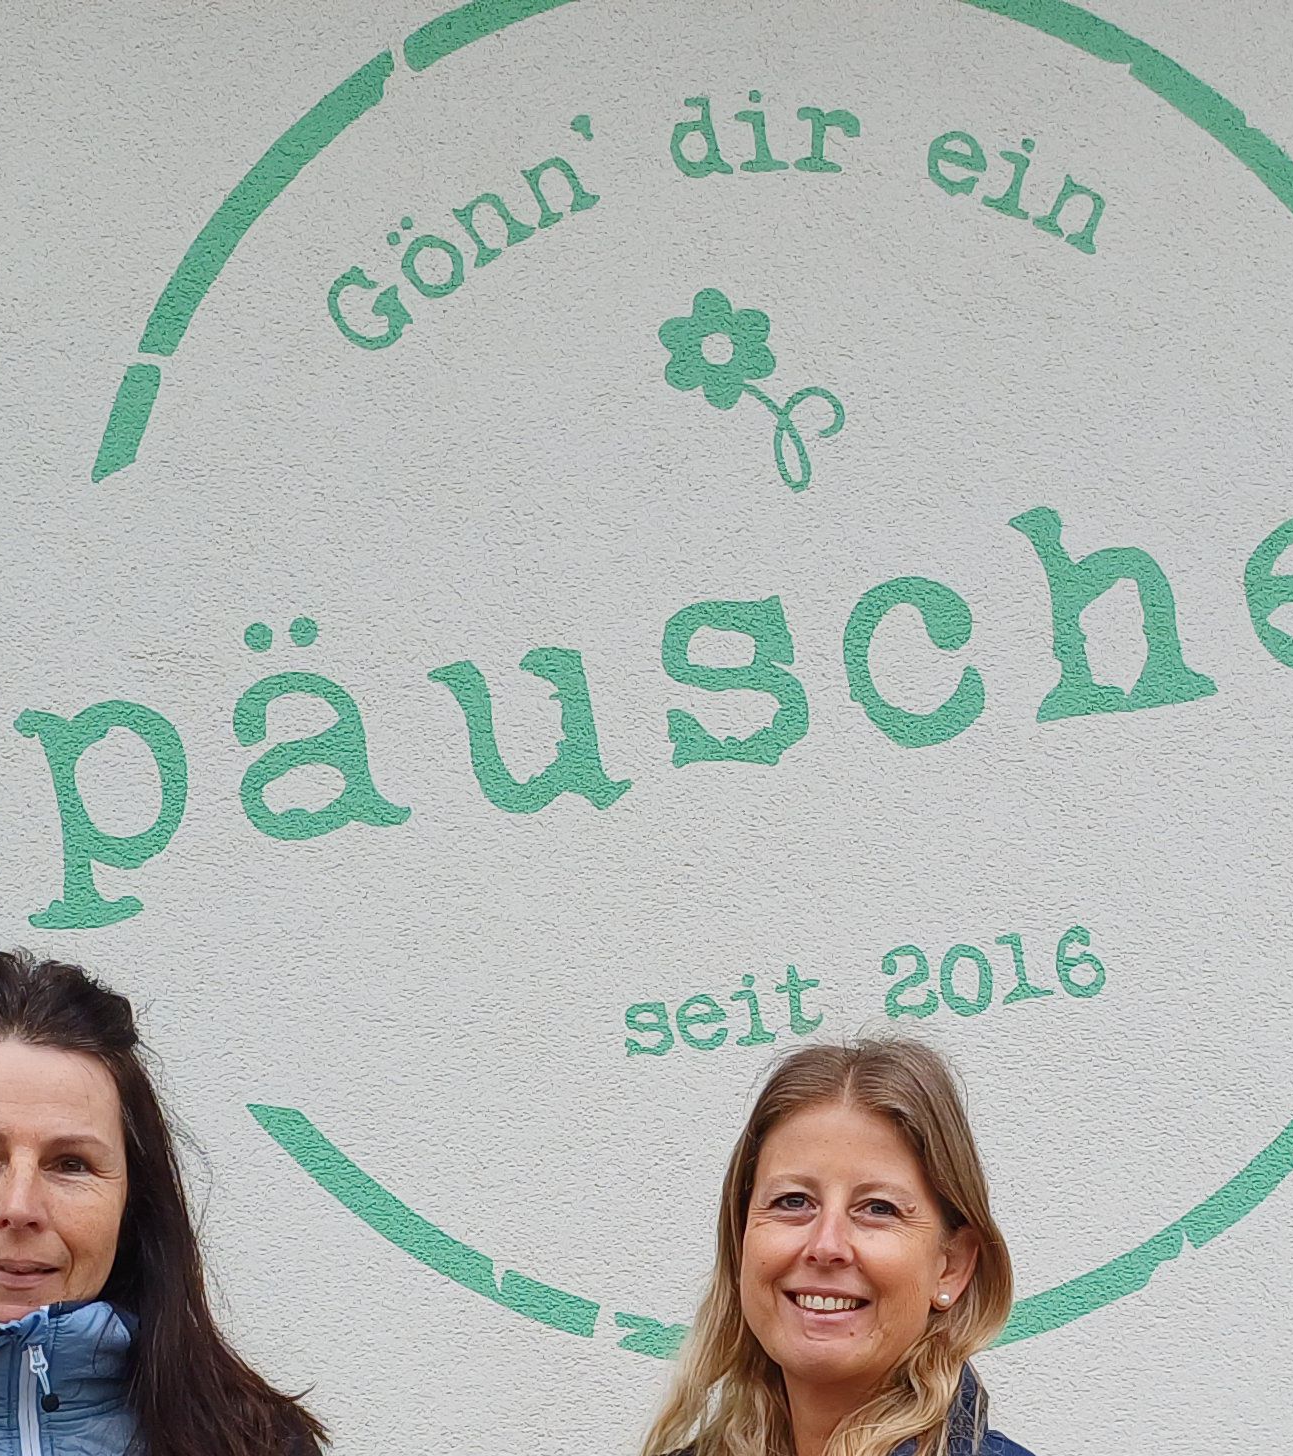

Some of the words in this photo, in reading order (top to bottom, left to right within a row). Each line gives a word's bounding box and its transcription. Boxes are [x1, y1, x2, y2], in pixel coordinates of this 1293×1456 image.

[669, 92, 862, 173] dir
[926, 130, 1107, 255] ein
[623, 965, 821, 1057] seit
[880, 925, 1107, 1019] 2016
